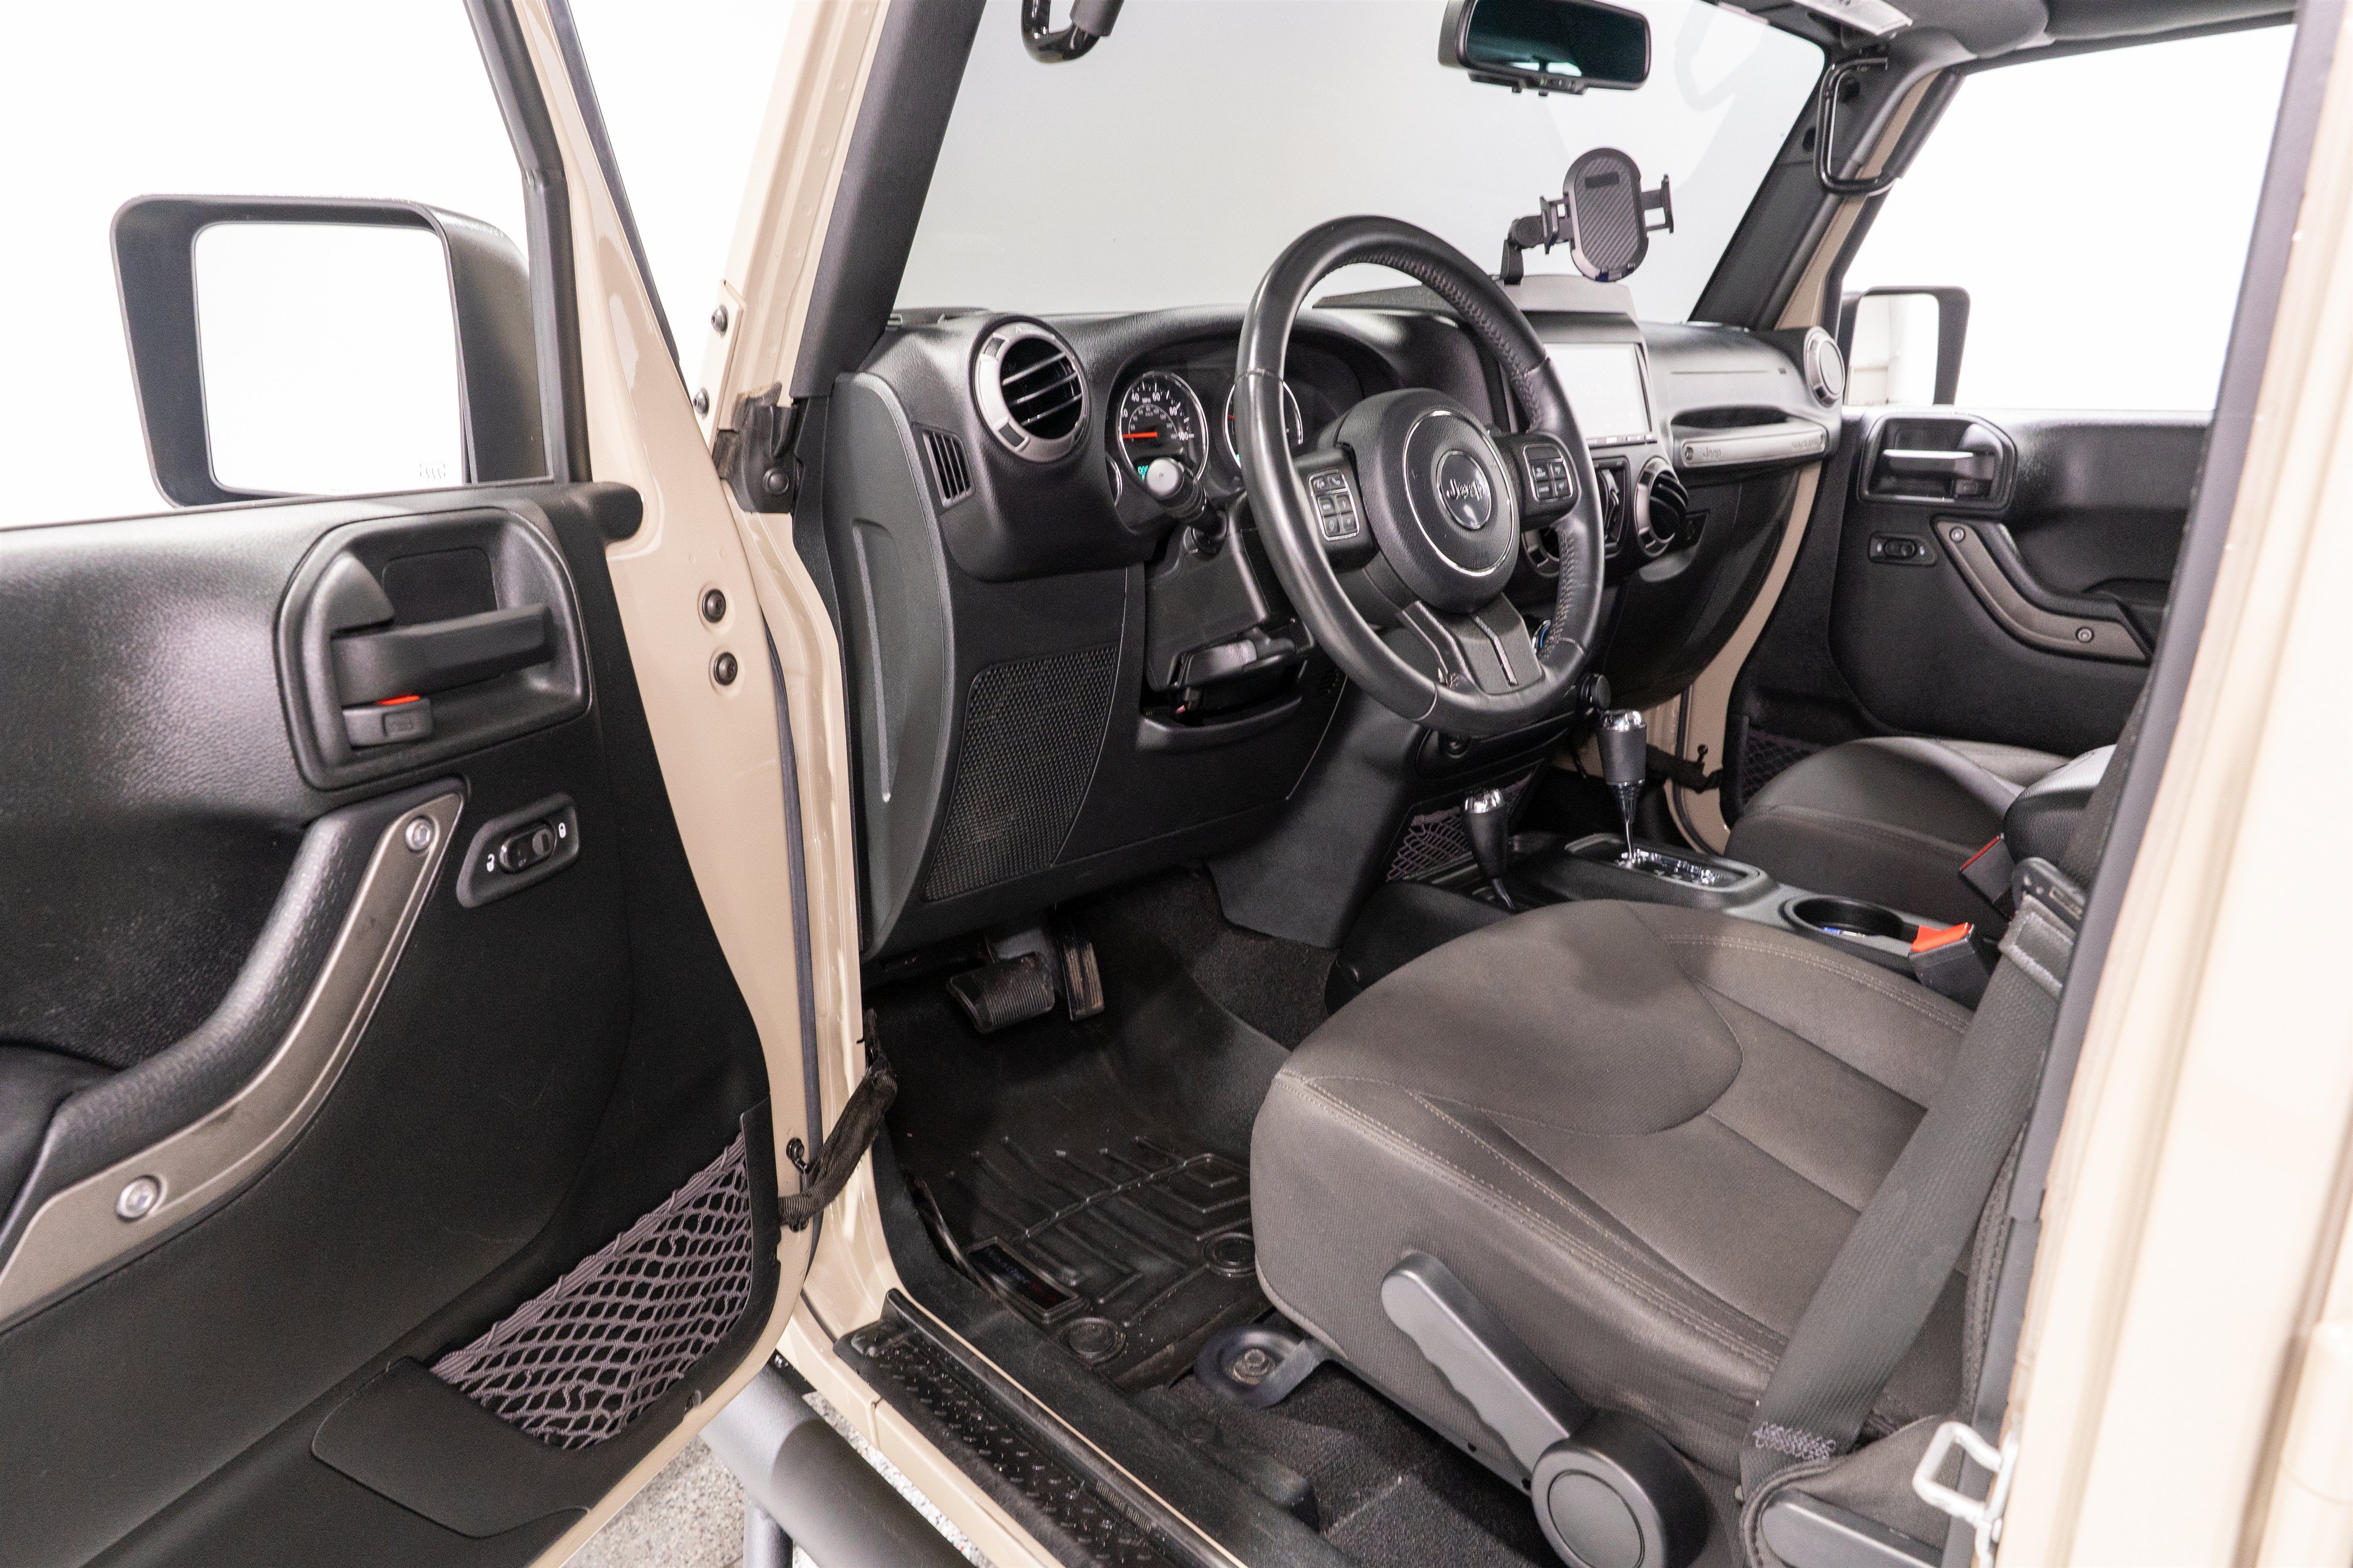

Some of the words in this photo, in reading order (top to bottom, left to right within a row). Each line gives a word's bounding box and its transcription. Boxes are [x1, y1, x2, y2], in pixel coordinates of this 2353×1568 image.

[1131, 393, 1139, 402] 40
[1152, 392, 1160, 401] 60
[1178, 431, 1189, 441] 100
[1446, 478, 1484, 501] Jeep
